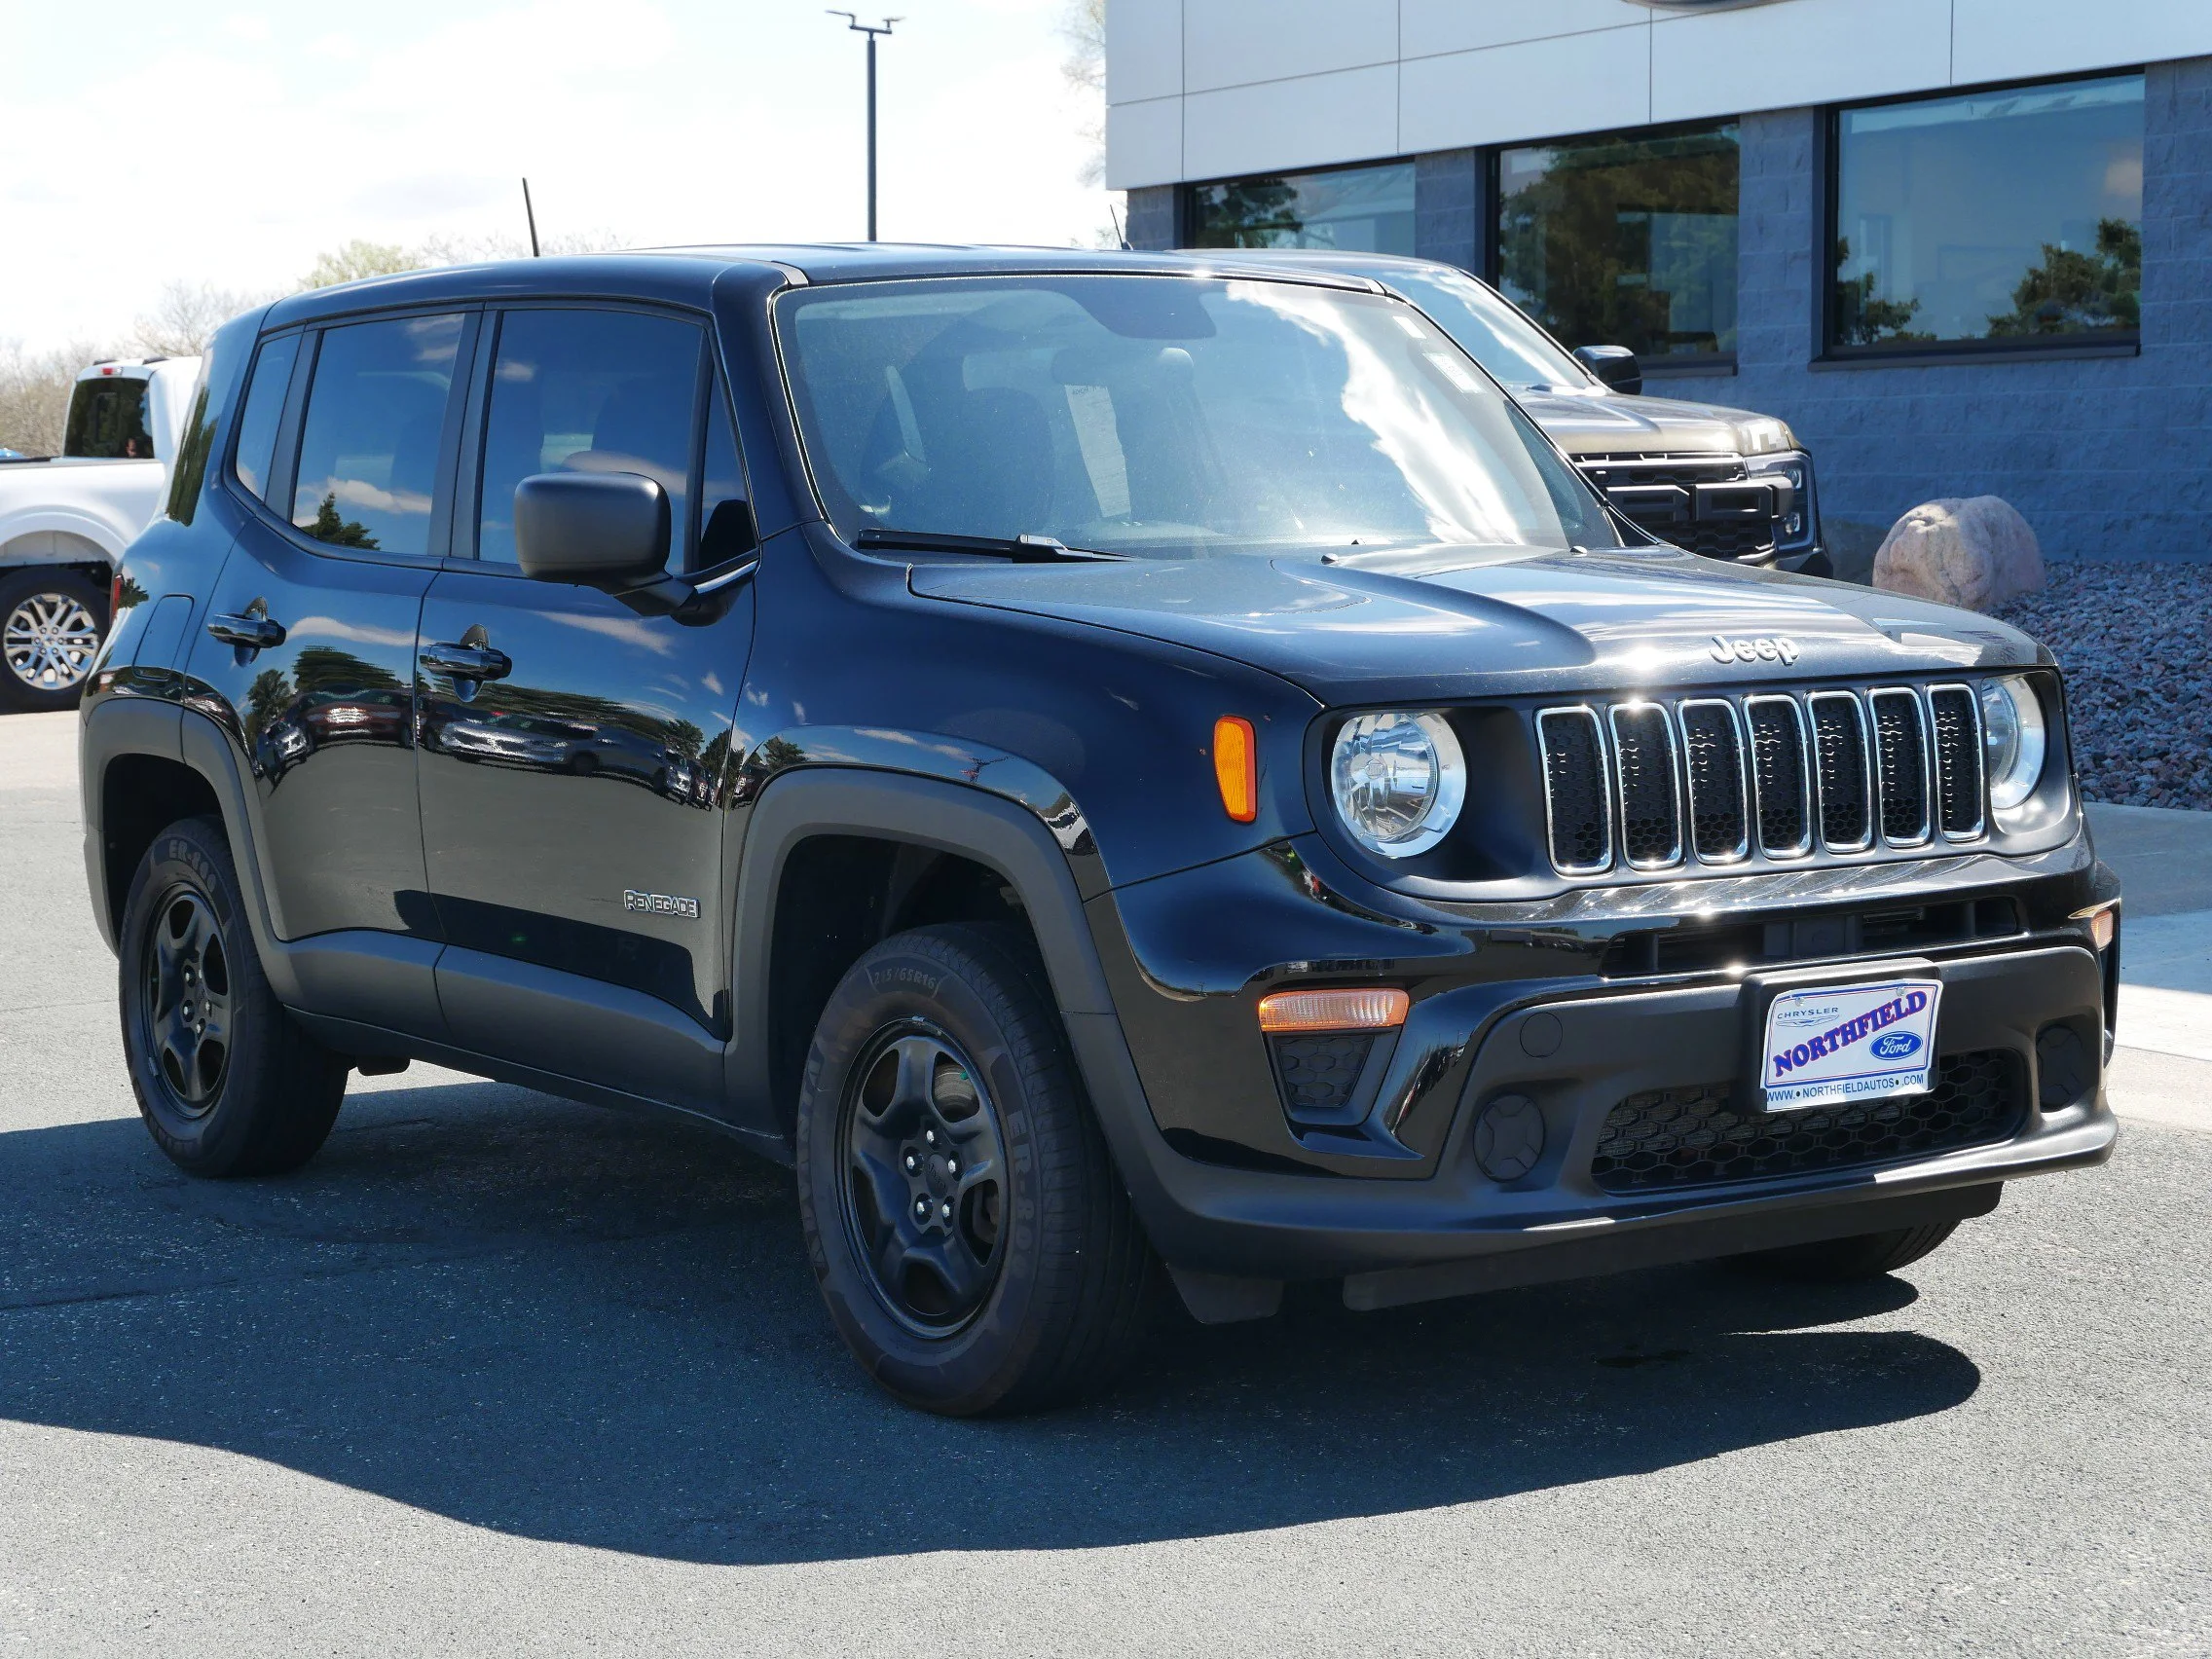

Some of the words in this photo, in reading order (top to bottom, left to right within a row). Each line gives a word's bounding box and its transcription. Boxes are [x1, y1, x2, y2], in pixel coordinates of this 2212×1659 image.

[1708, 634, 1800, 666] Jeep
[623, 889, 701, 918] RENEGADE
[1777, 1007, 1839, 1019] CHRYSLER
[1773, 990, 1927, 1077] NORTHFIELD
[1879, 1036, 1911, 1057] Ford
